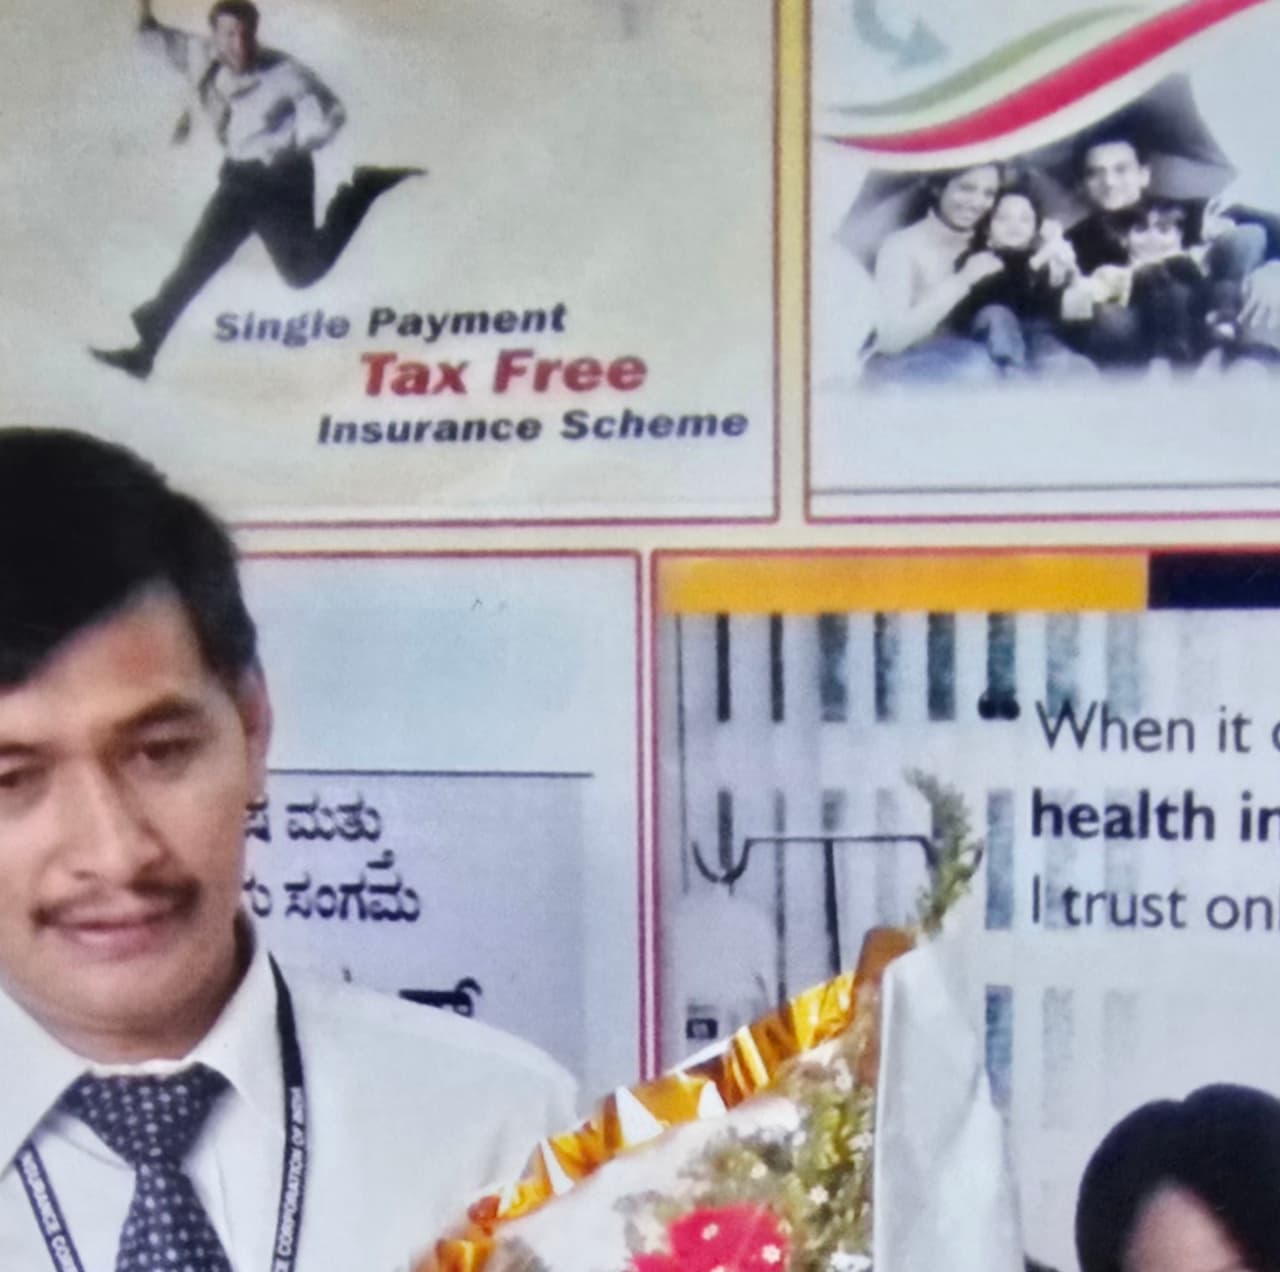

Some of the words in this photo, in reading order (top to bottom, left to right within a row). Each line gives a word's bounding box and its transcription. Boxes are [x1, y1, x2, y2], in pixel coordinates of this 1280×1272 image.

[215, 311, 350, 347] Single
[368, 302, 567, 344] Payment
[360, 351, 471, 396] Tax
[492, 349, 648, 393] Free
[318, 413, 543, 446] Insurance
[560, 409, 750, 441] Scheme
[1219, 705, 1252, 754] it
[1031, 787, 1216, 842] health
[1031, 874, 1043, 926] I
[1063, 883, 1188, 930] trust
